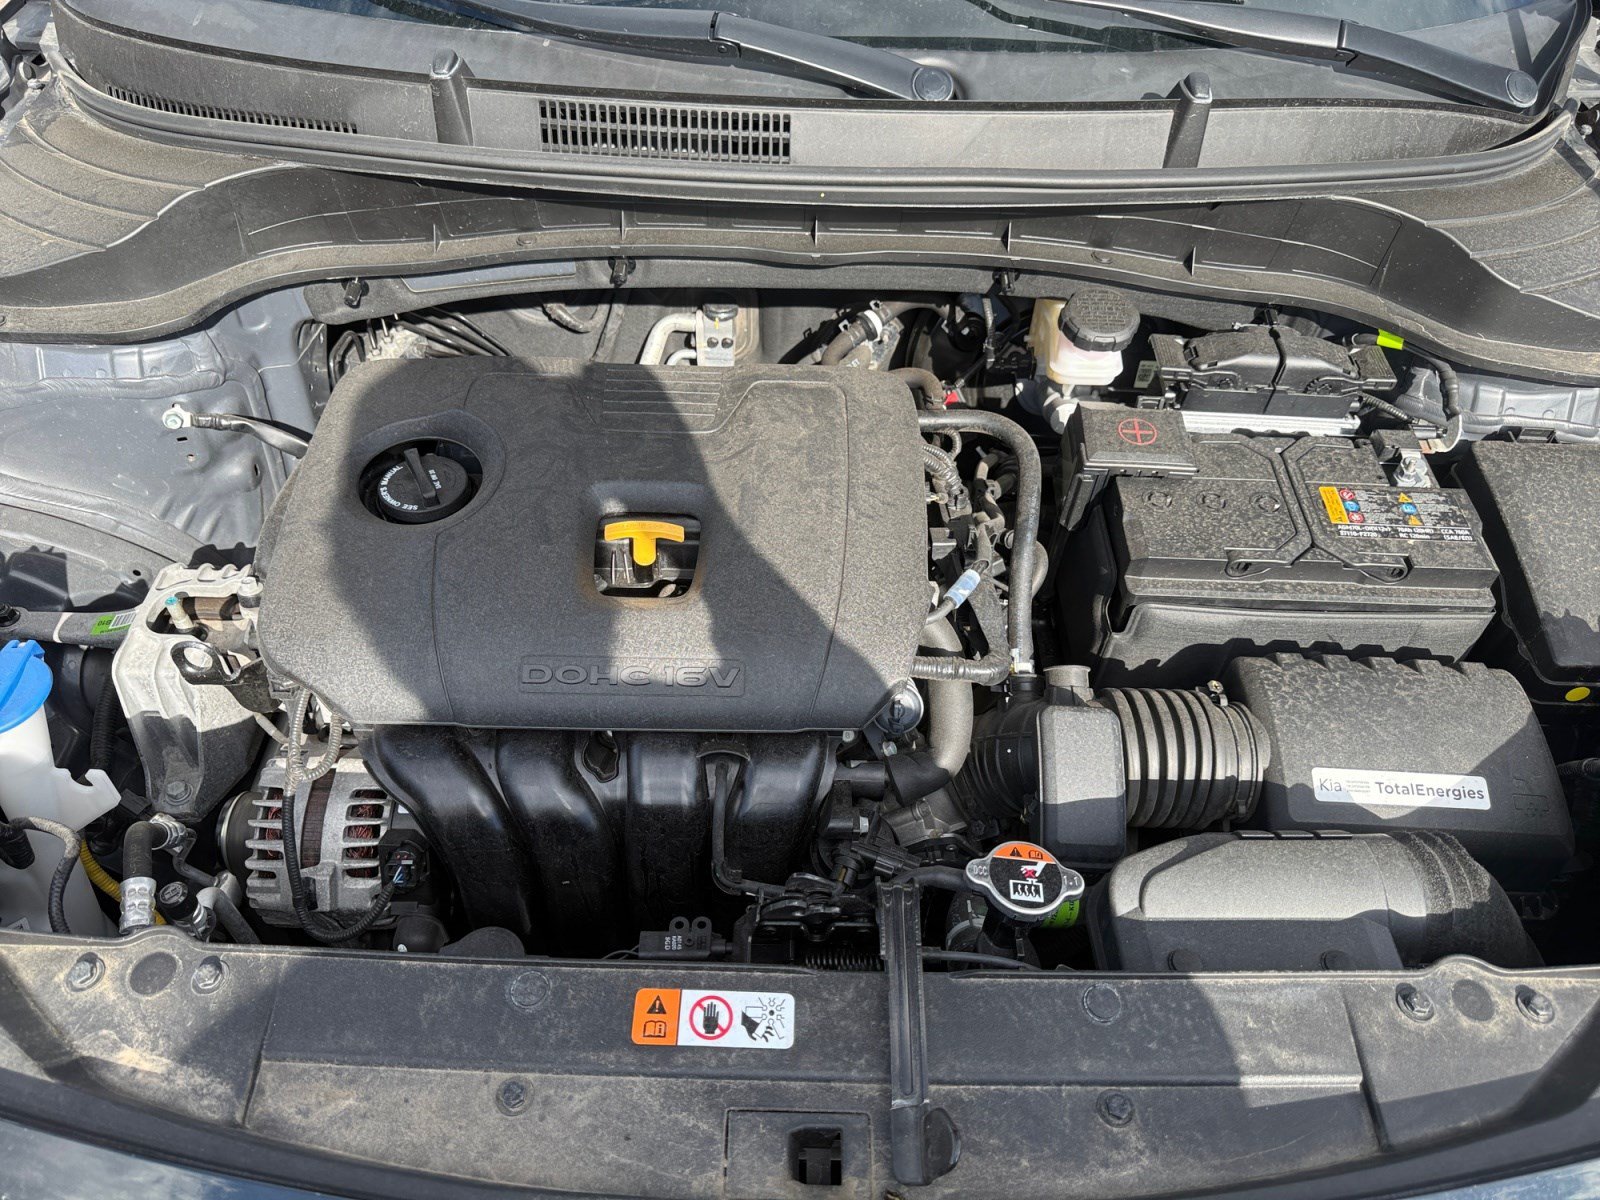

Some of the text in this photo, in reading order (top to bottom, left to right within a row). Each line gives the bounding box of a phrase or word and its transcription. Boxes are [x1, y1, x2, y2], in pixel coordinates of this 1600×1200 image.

[380, 465, 403, 486] MANUAL
[521, 664, 741, 688] DOHC 16V
[1319, 778, 1343, 792] Kia
[1375, 781, 1486, 801] TotalEnergies
